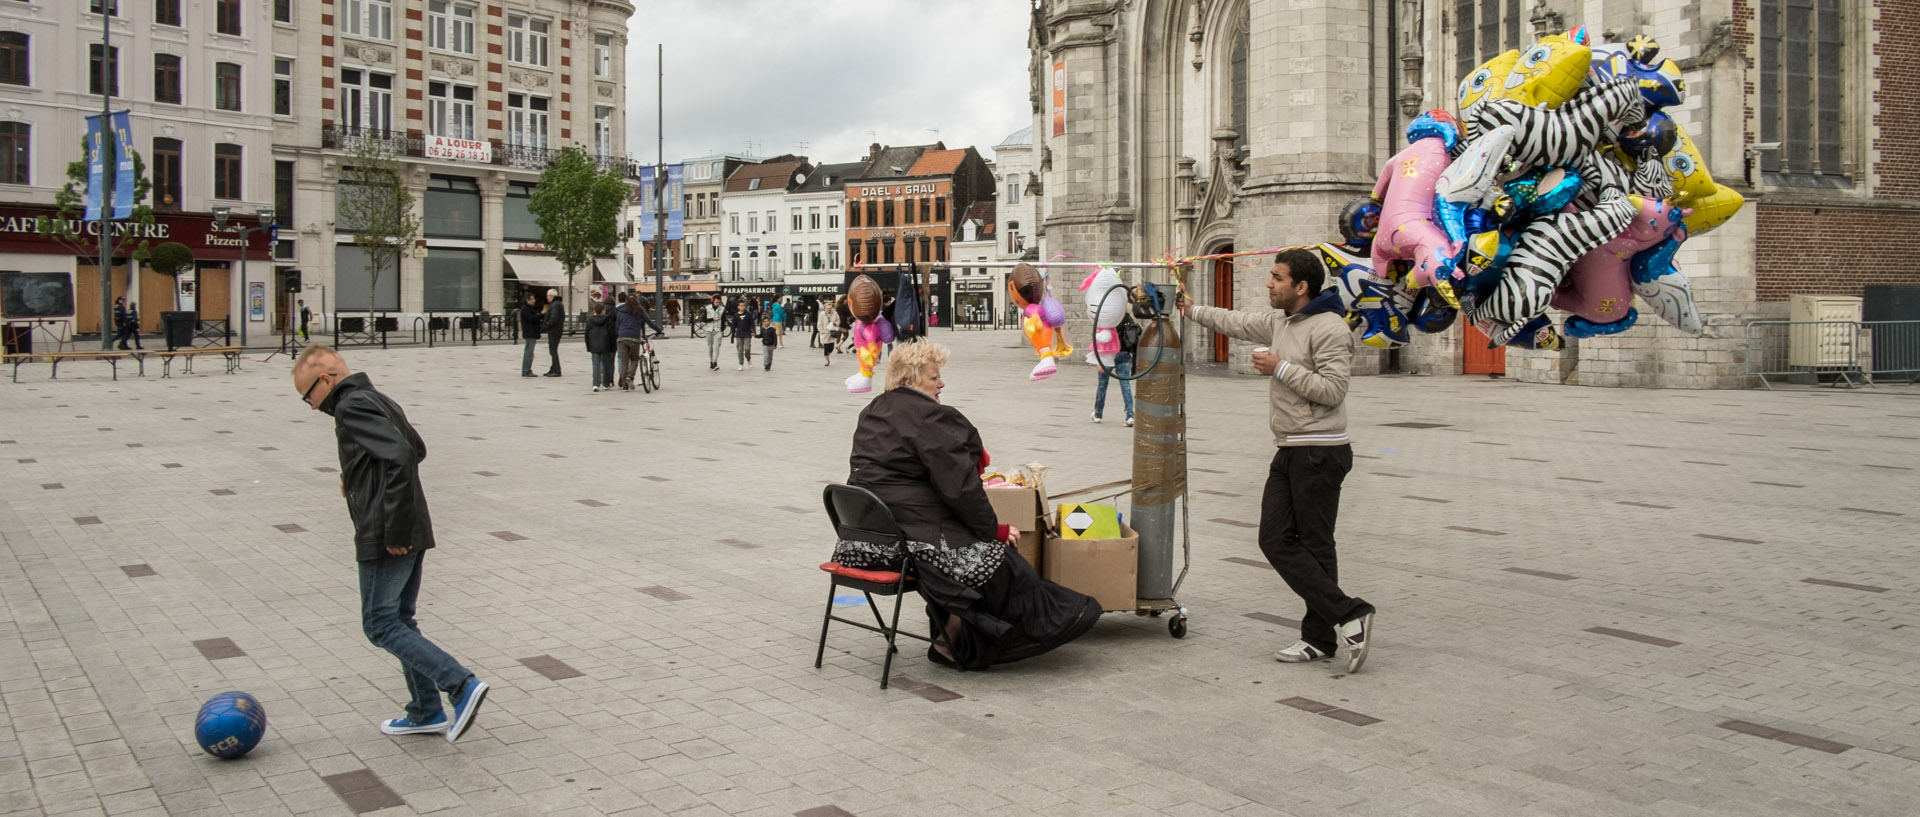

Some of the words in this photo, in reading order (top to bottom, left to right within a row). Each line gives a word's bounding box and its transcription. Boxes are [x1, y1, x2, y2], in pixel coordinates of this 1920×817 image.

[118, 128, 126, 142] 11
[436, 137, 443, 145] A
[447, 139, 482, 150] LOUER
[124, 144, 133, 159] 12
[429, 147, 439, 156] 06
[442, 148, 452, 158] 26
[455, 149, 465, 159] 26
[469, 151, 478, 160] 18
[480, 152, 489, 161] 21
[861, 187, 891, 197] DAEL
[895, 187, 901, 195] &
[905, 183, 936, 195] GRAU
[798, 285, 839, 293] PHARMACIE
[209, 736, 239, 753] FCB
